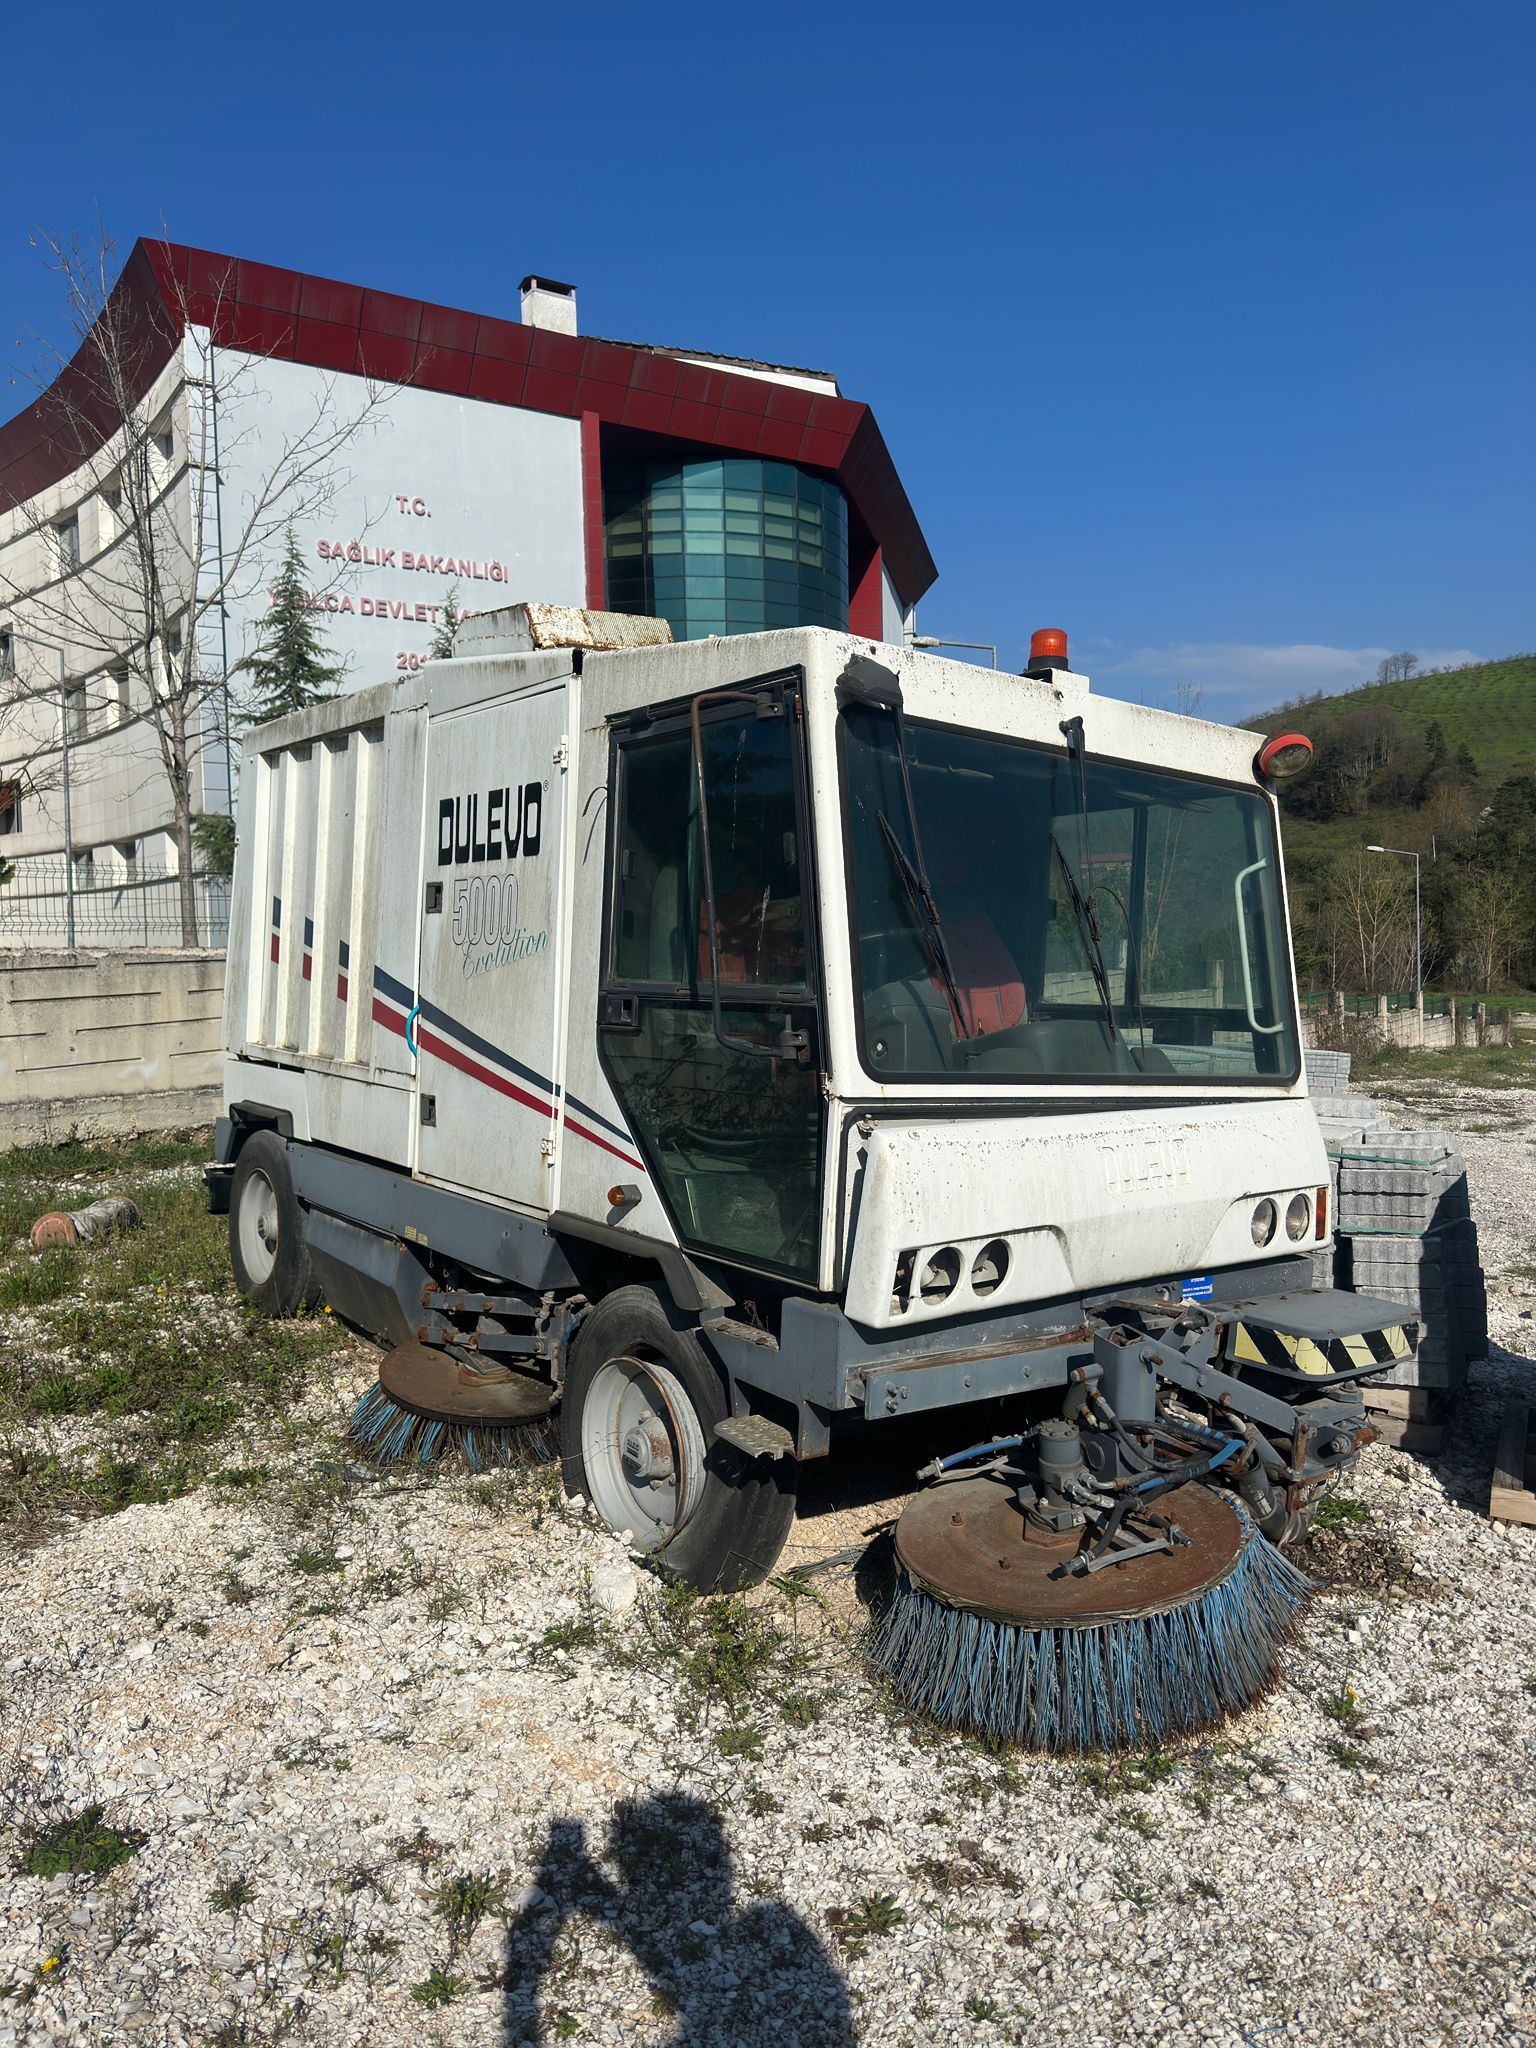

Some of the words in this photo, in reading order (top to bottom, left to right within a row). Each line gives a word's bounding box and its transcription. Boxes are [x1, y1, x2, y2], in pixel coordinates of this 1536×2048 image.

[395, 495, 432, 517] T.C.
[316, 538, 396, 569] SAĞLIK
[401, 551, 509, 583] BAKANLIĞI
[360, 597, 439, 624] DEVLET
[438, 781, 542, 867] DULEVO
[452, 874, 518, 946] 5000
[462, 925, 547, 980] Evolution
